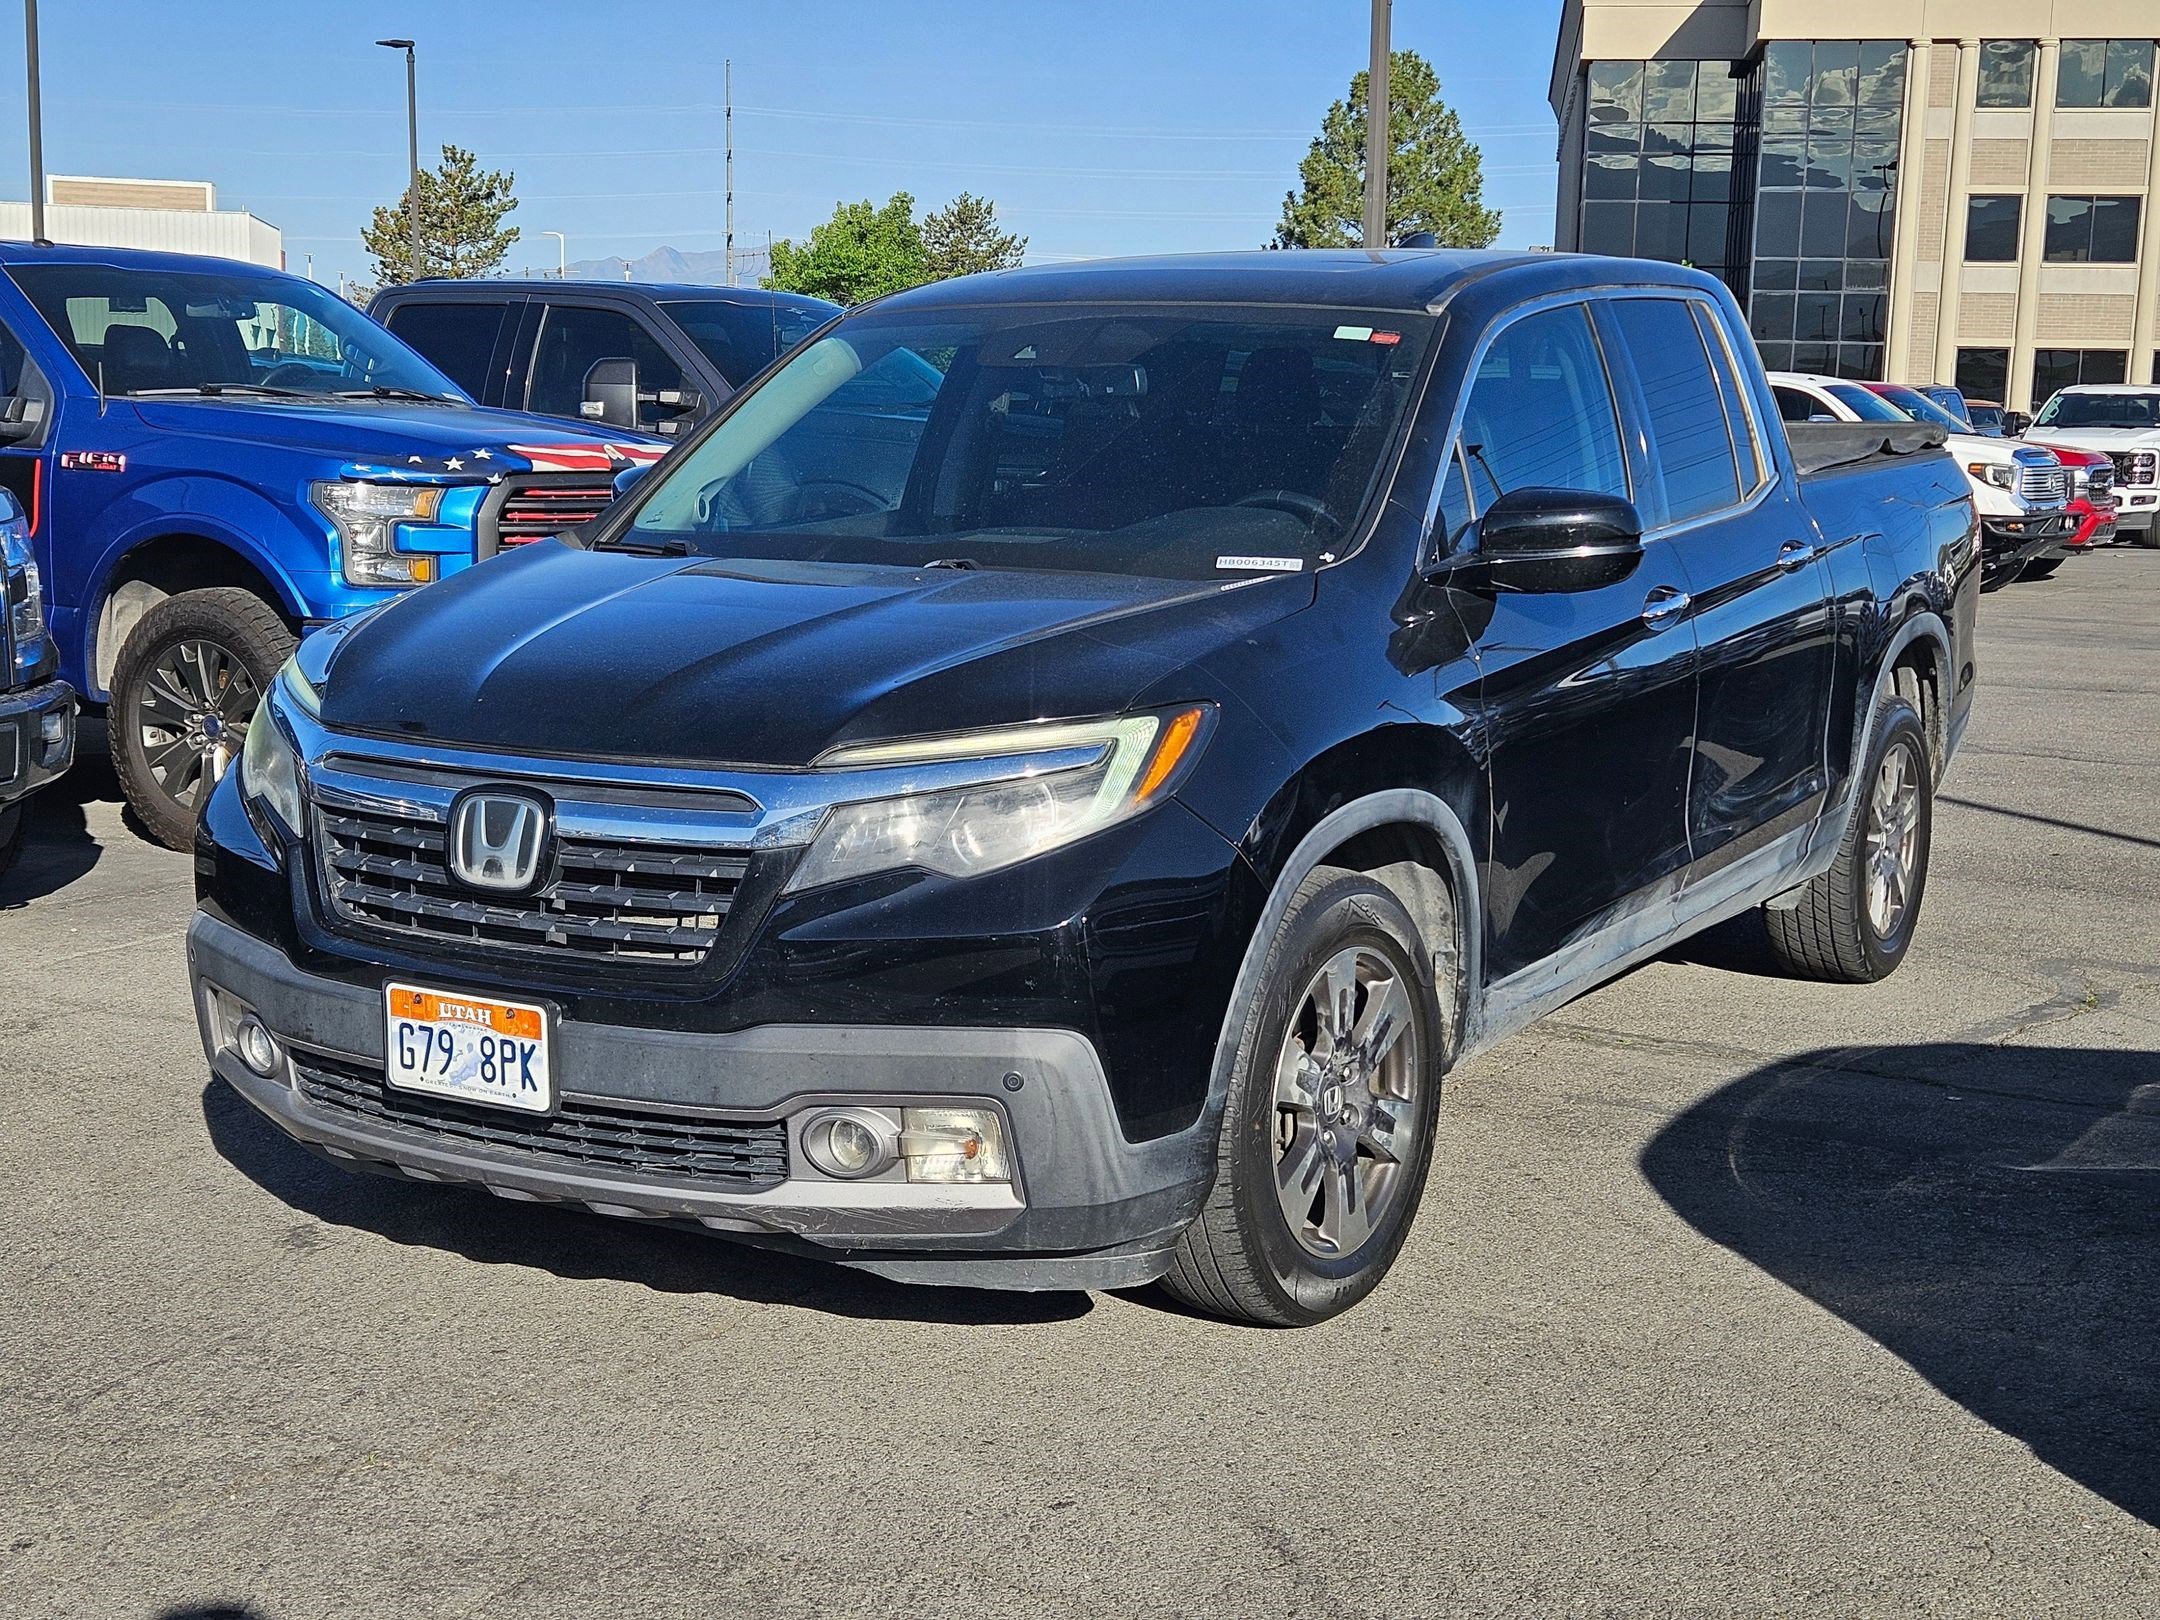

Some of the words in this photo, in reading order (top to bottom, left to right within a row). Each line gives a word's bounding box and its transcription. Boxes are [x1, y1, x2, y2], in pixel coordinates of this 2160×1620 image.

[438, 1002, 492, 1026] UTAH
[399, 1022, 454, 1075] G79
[480, 1035, 538, 1092] 8PK
